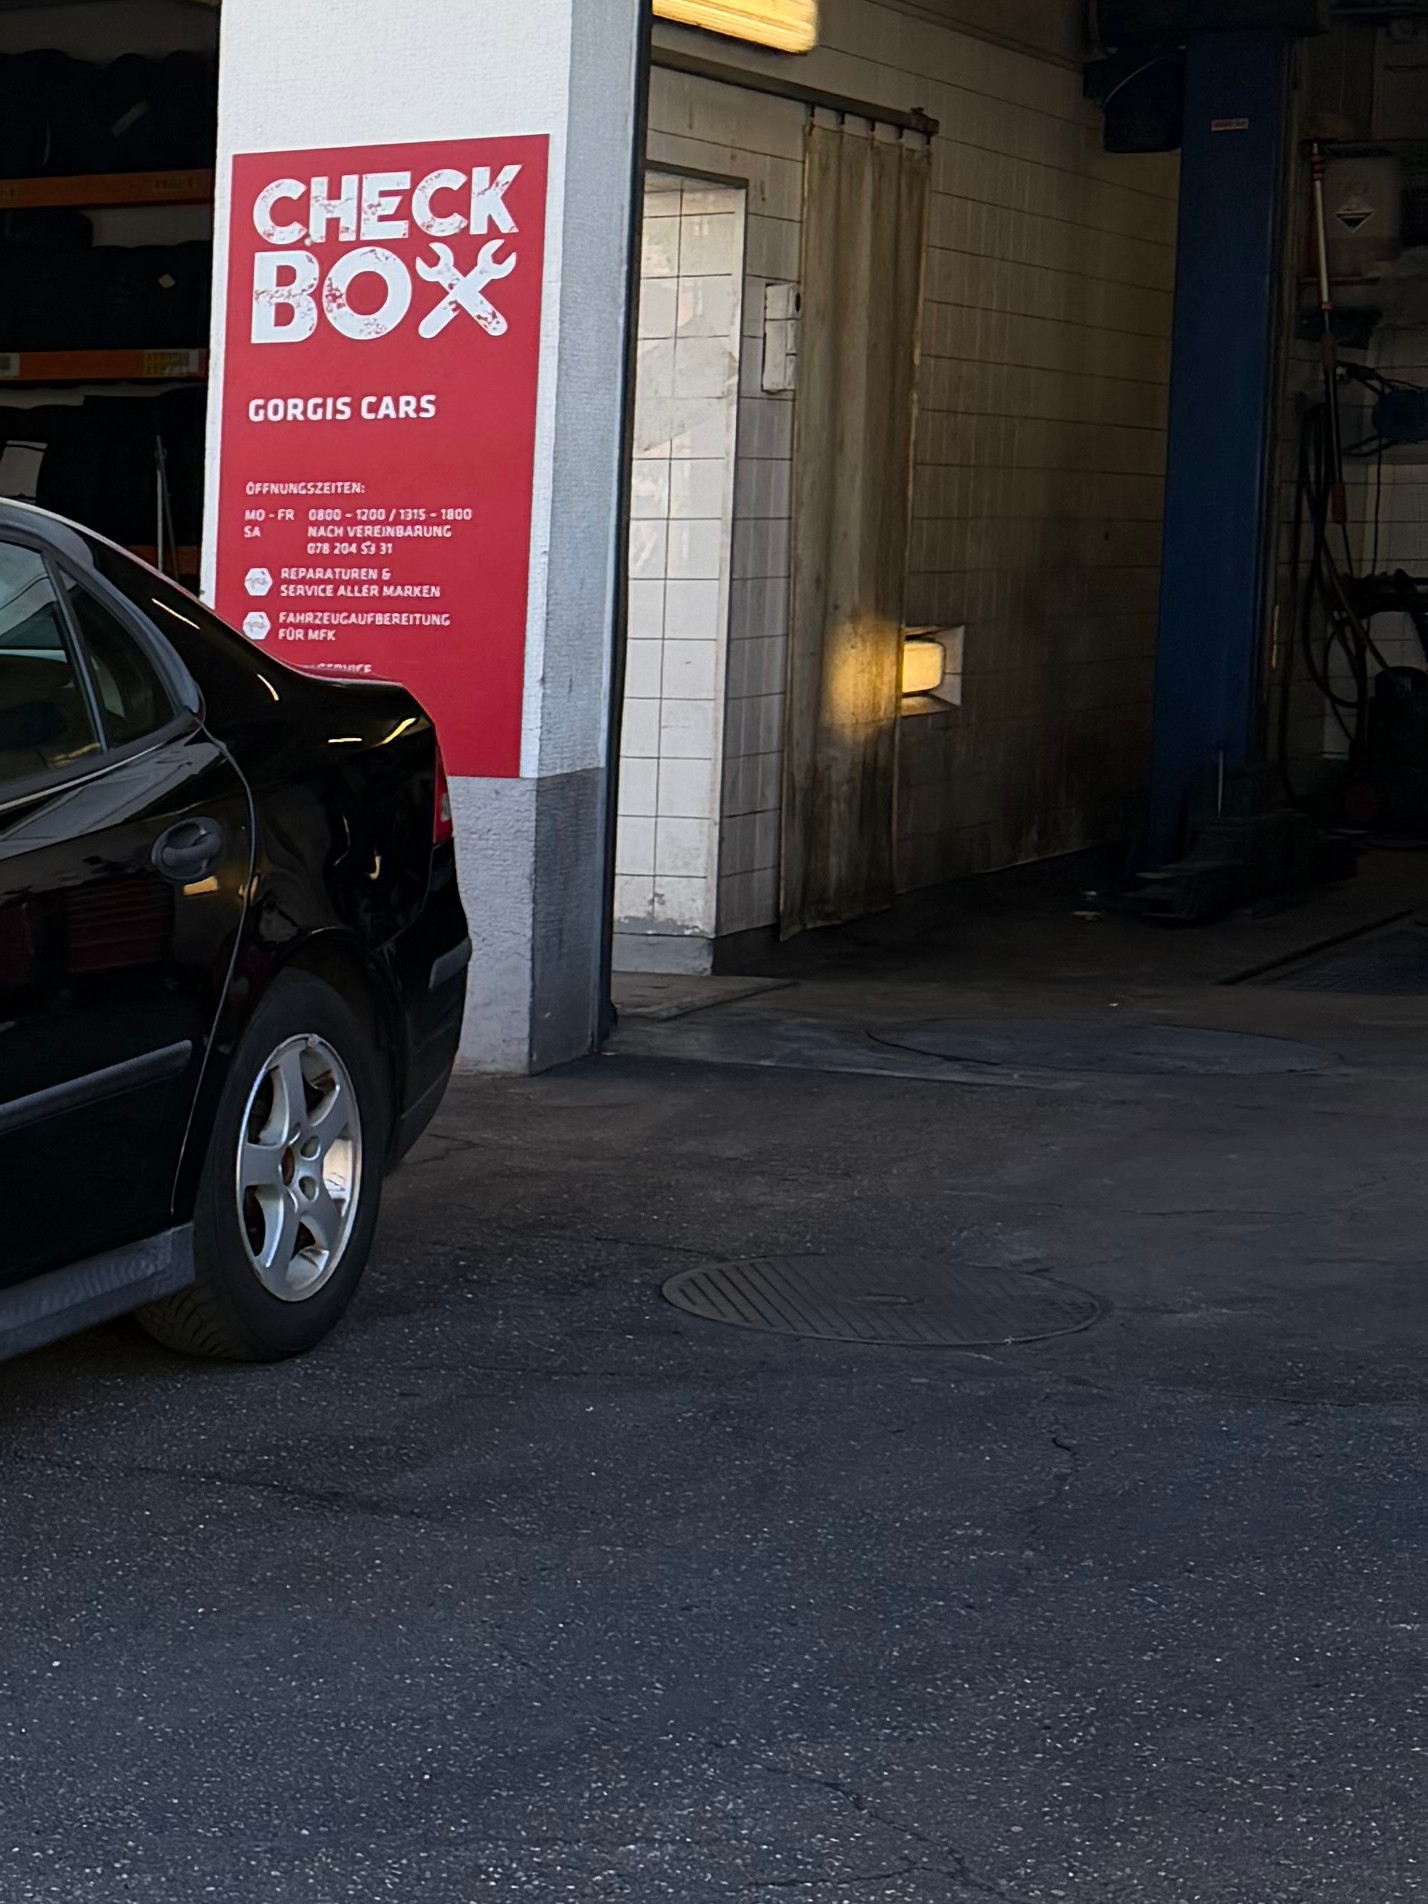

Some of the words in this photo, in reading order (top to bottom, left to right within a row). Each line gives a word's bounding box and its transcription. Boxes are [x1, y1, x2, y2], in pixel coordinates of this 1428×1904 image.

[253, 164, 522, 245] CHECK
[251, 239, 517, 344] BOX
[248, 396, 352, 422] GORGIS
[360, 395, 436, 420] CARS
[246, 481, 365, 495] ÖFFNUNGSZEITEN:
[245, 509, 265, 521] MO
[277, 509, 295, 520] FR
[308, 508, 341, 521] 0800
[356, 508, 385, 521] 1200
[389, 508, 396, 522] /
[400, 508, 426, 521] 1315
[441, 508, 472, 521] 1800
[244, 526, 261, 538] SA
[308, 526, 344, 538] NACH
[347, 525, 452, 538] VEREINBARUNG
[307, 542, 330, 555] 078
[333, 542, 357, 555] 204
[360, 541, 376, 555] 53
[379, 542, 393, 555] 31
[280, 568, 378, 580] REPARATUREN
[382, 568, 392, 580] &
[280, 585, 334, 597] SERVICE
[337, 585, 379, 597] ALLER
[383, 585, 441, 598] MARKEN
[279, 612, 451, 626] FAHRZEUGAUFBEREITUNG
[278, 628, 305, 641] FÜR
[307, 629, 336, 641] MFK
